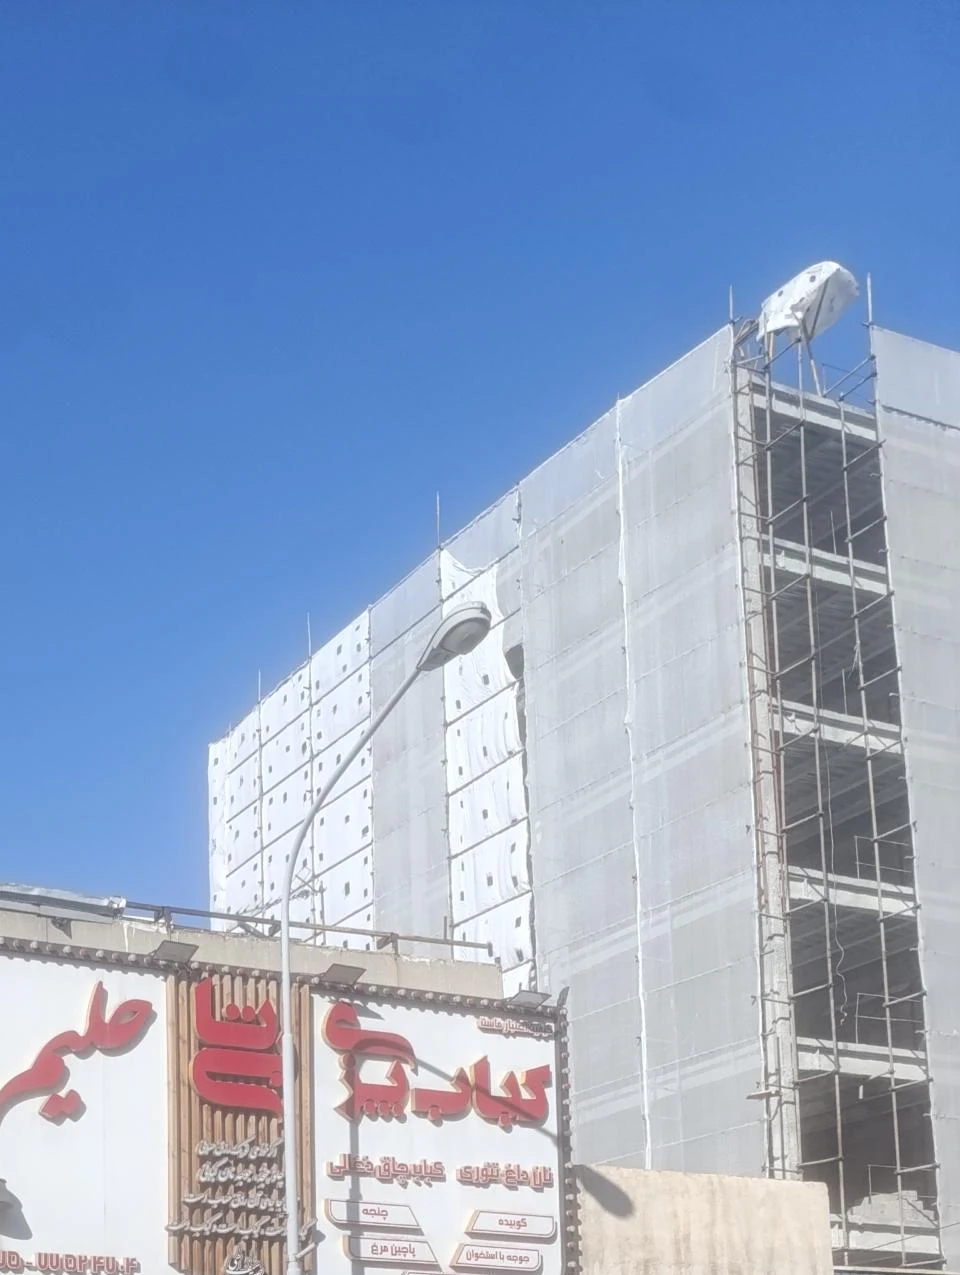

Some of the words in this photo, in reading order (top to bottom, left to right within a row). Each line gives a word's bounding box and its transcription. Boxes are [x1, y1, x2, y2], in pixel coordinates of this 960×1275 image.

[411, 1055, 553, 1127] کباب
[411, 1160, 446, 1185] کباب
[456, 1162, 500, 1184] تنوری
[504, 1163, 529, 1186] داغ
[530, 1164, 554, 1187] نان
[362, 1207, 389, 1220] چنجه
[498, 1218, 528, 1230] کوبیده
[370, 1243, 390, 1255] مرغ
[390, 1243, 416, 1258] پاچین
[465, 1249, 499, 1261] استخوان
[506, 1253, 530, 1264] جوجه
